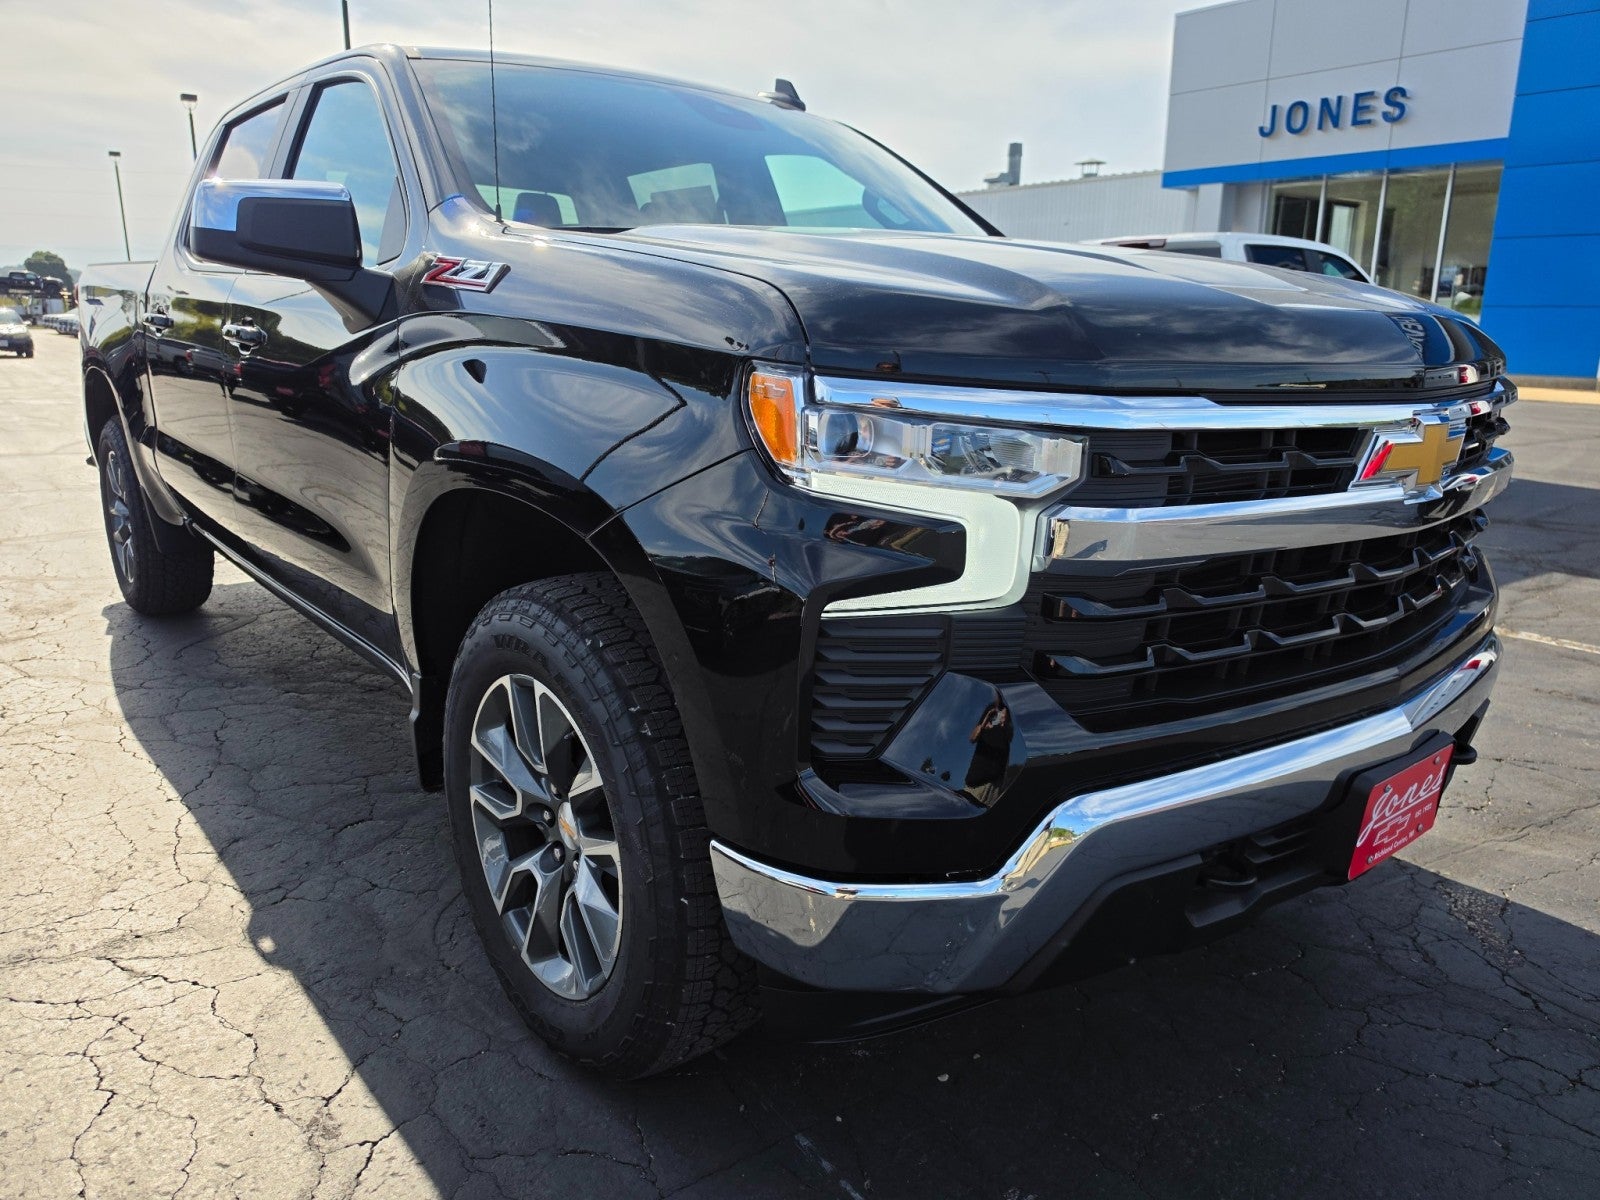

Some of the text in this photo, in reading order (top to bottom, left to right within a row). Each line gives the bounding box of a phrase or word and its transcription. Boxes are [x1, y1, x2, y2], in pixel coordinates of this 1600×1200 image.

[1258, 86, 1408, 138] JONES
[420, 255, 511, 294] Z71
[1356, 763, 1447, 848] Jones
